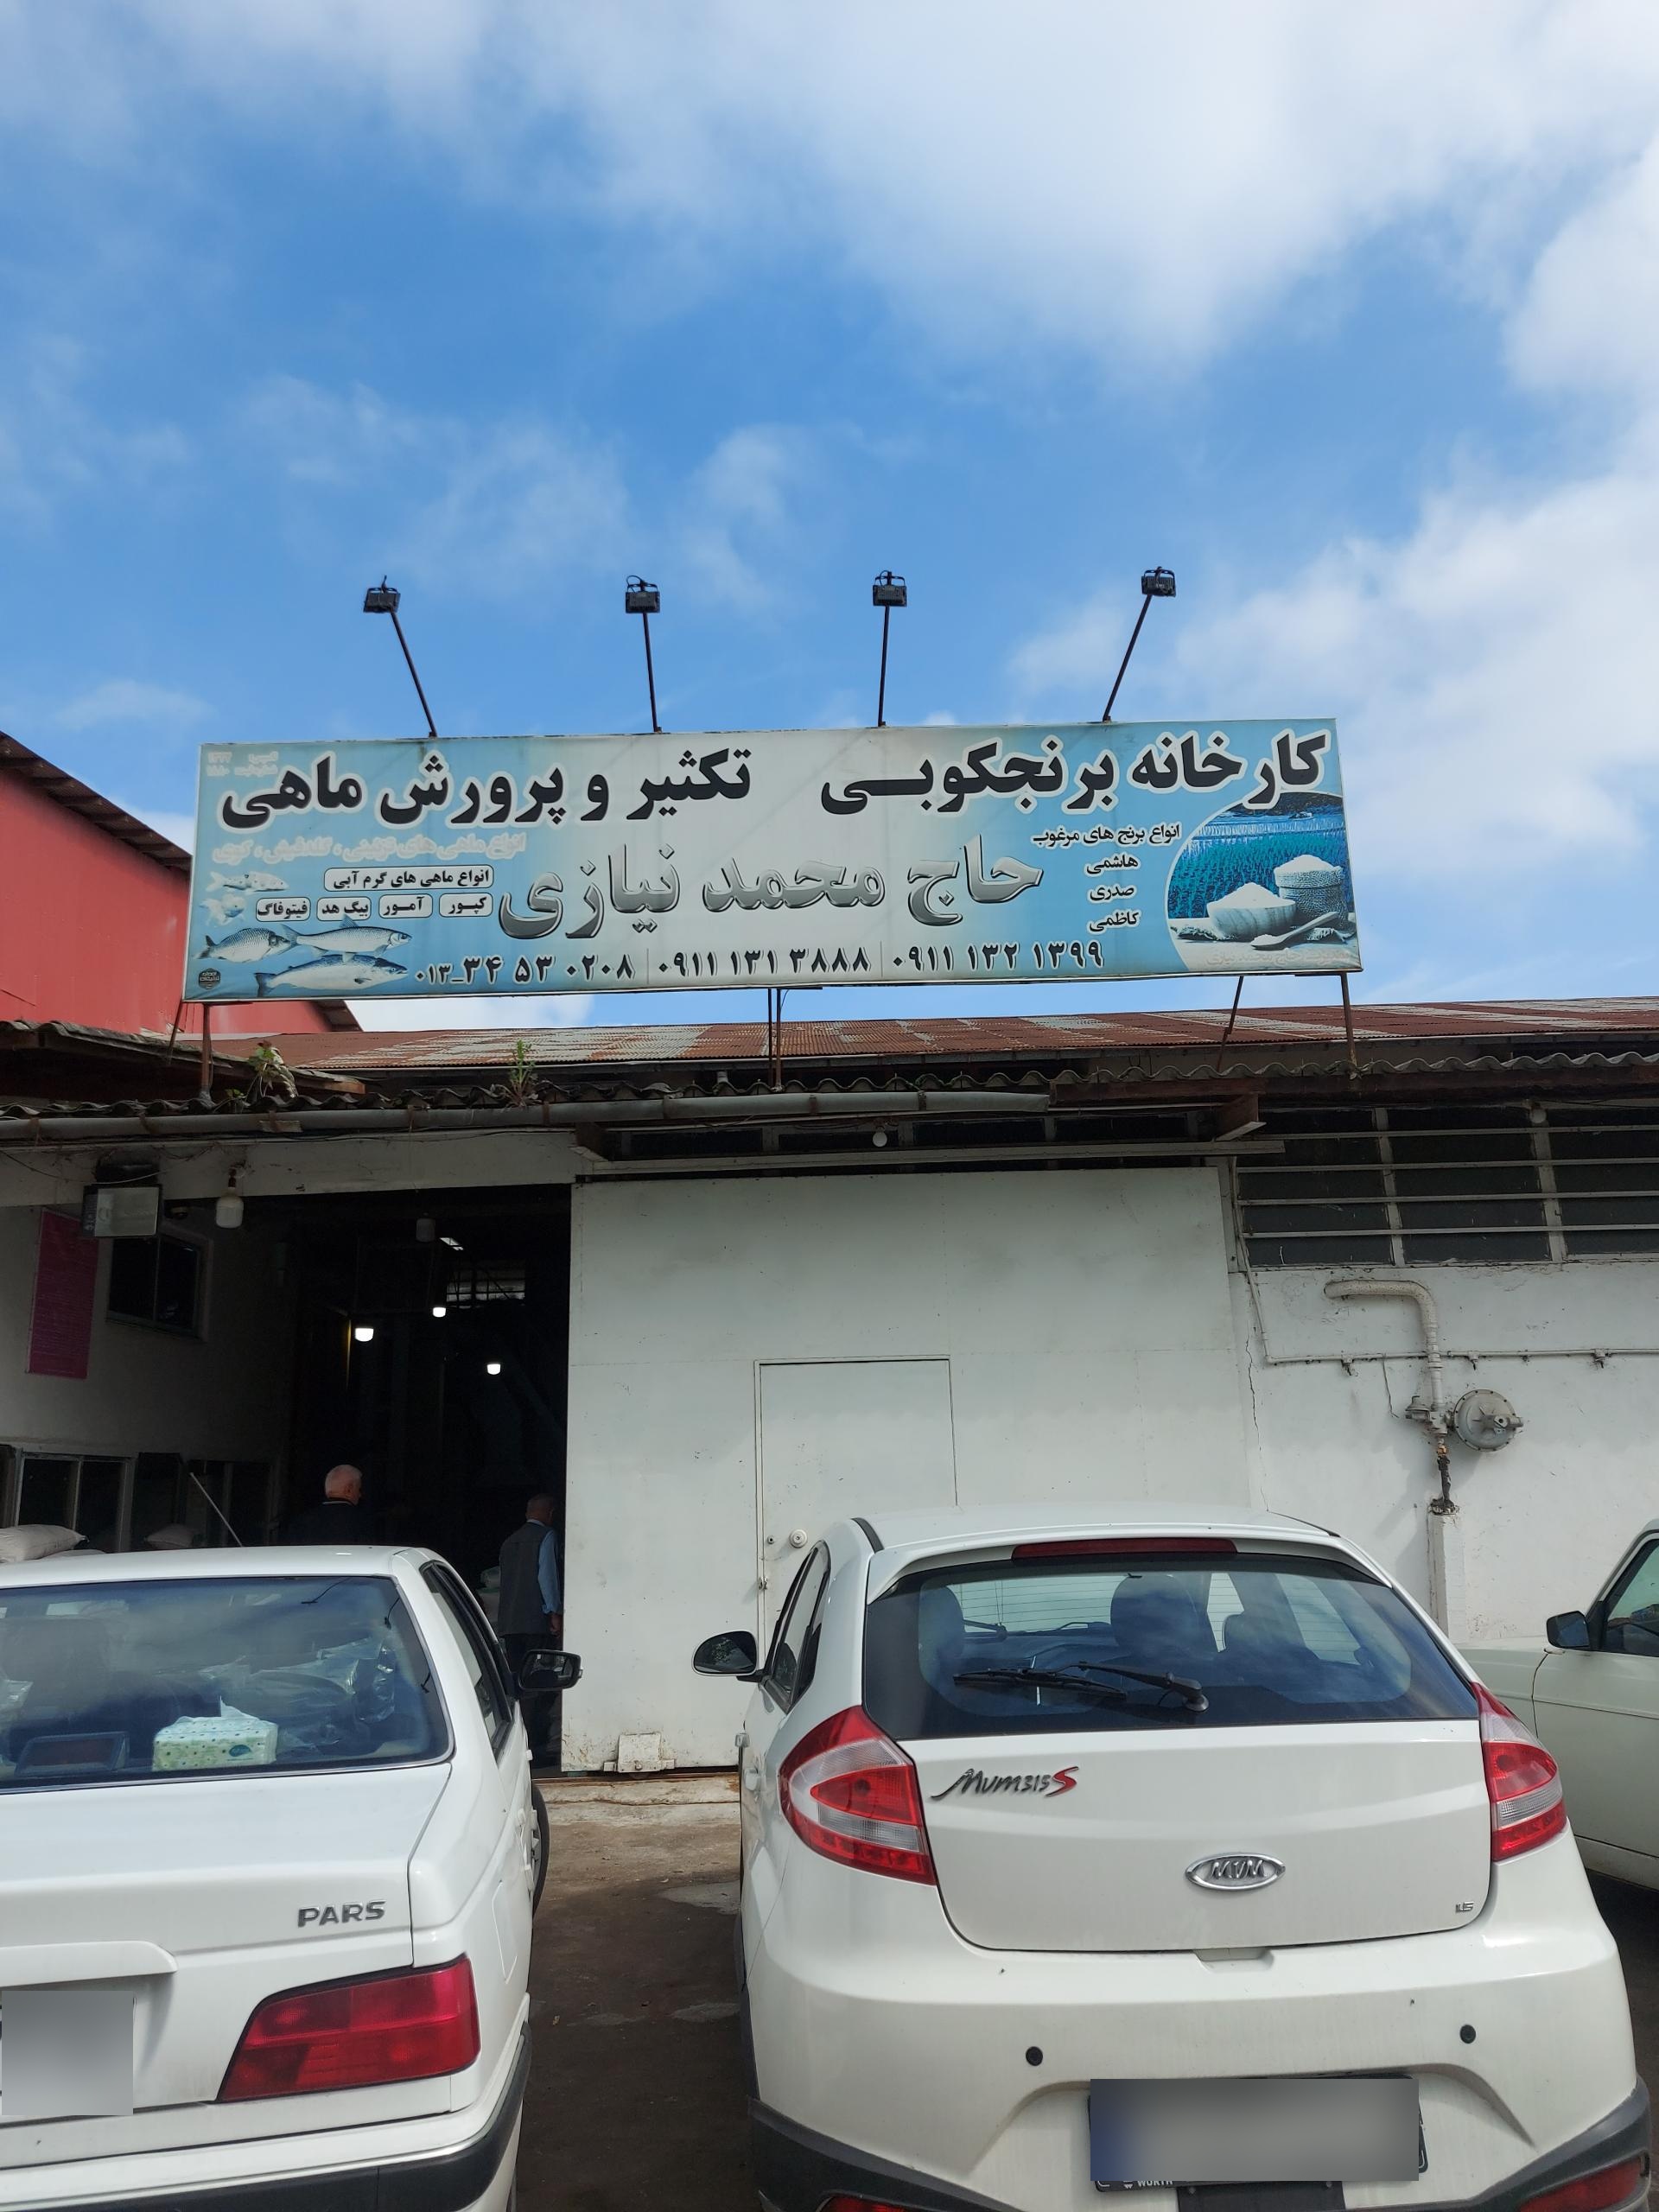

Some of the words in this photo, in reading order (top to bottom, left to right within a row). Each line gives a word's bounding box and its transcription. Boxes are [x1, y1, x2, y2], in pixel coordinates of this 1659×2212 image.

[821, 740, 1116, 816] برنجکوبی
[1131, 733, 1327, 804] کارخانه
[222, 755, 363, 829] ماهی
[380, 754, 567, 825] پرورش
[626, 747, 752, 820] تکثیر
[580, 773, 609, 821] و
[1033, 827, 1080, 848] مرغوب
[1083, 825, 1115, 844] های
[1117, 824, 1146, 845] برنج
[1149, 824, 1180, 844] انواع
[1086, 854, 1139, 874] هاشمی
[333, 869, 360, 890] آبی
[363, 871, 387, 889] گرم
[391, 870, 416, 888] های
[420, 870, 454, 889] ماهی
[457, 868, 489, 887] انواع
[702, 857, 886, 912] محمد
[906, 834, 1045, 927] حاج
[499, 842, 682, 940] نیازی
[1090, 885, 1135, 901] صدری
[257, 899, 308, 918] فیتوفاگ
[321, 903, 340, 915] هد
[343, 899, 370, 917] بیگ
[383, 895, 424, 916] آمور
[448, 895, 487, 915] کپور
[1089, 911, 1140, 932] کاظمی
[658, 951, 716, 977] ۰۹۱۱
[730, 950, 776, 975] ۱۳۱
[789, 947, 870, 973] ۳۸۸۸
[893, 946, 951, 971] ۰۹۱۱
[968, 943, 1018, 969] ۱۳۲
[1033, 941, 1103, 968] ۱۳۹۹
[514, 956, 553, 982] ۵۳
[566, 953, 633, 980] ۰۲۰۸
[1210, 1859, 1268, 1880] MVM
[297, 1900, 386, 1928] PARS
